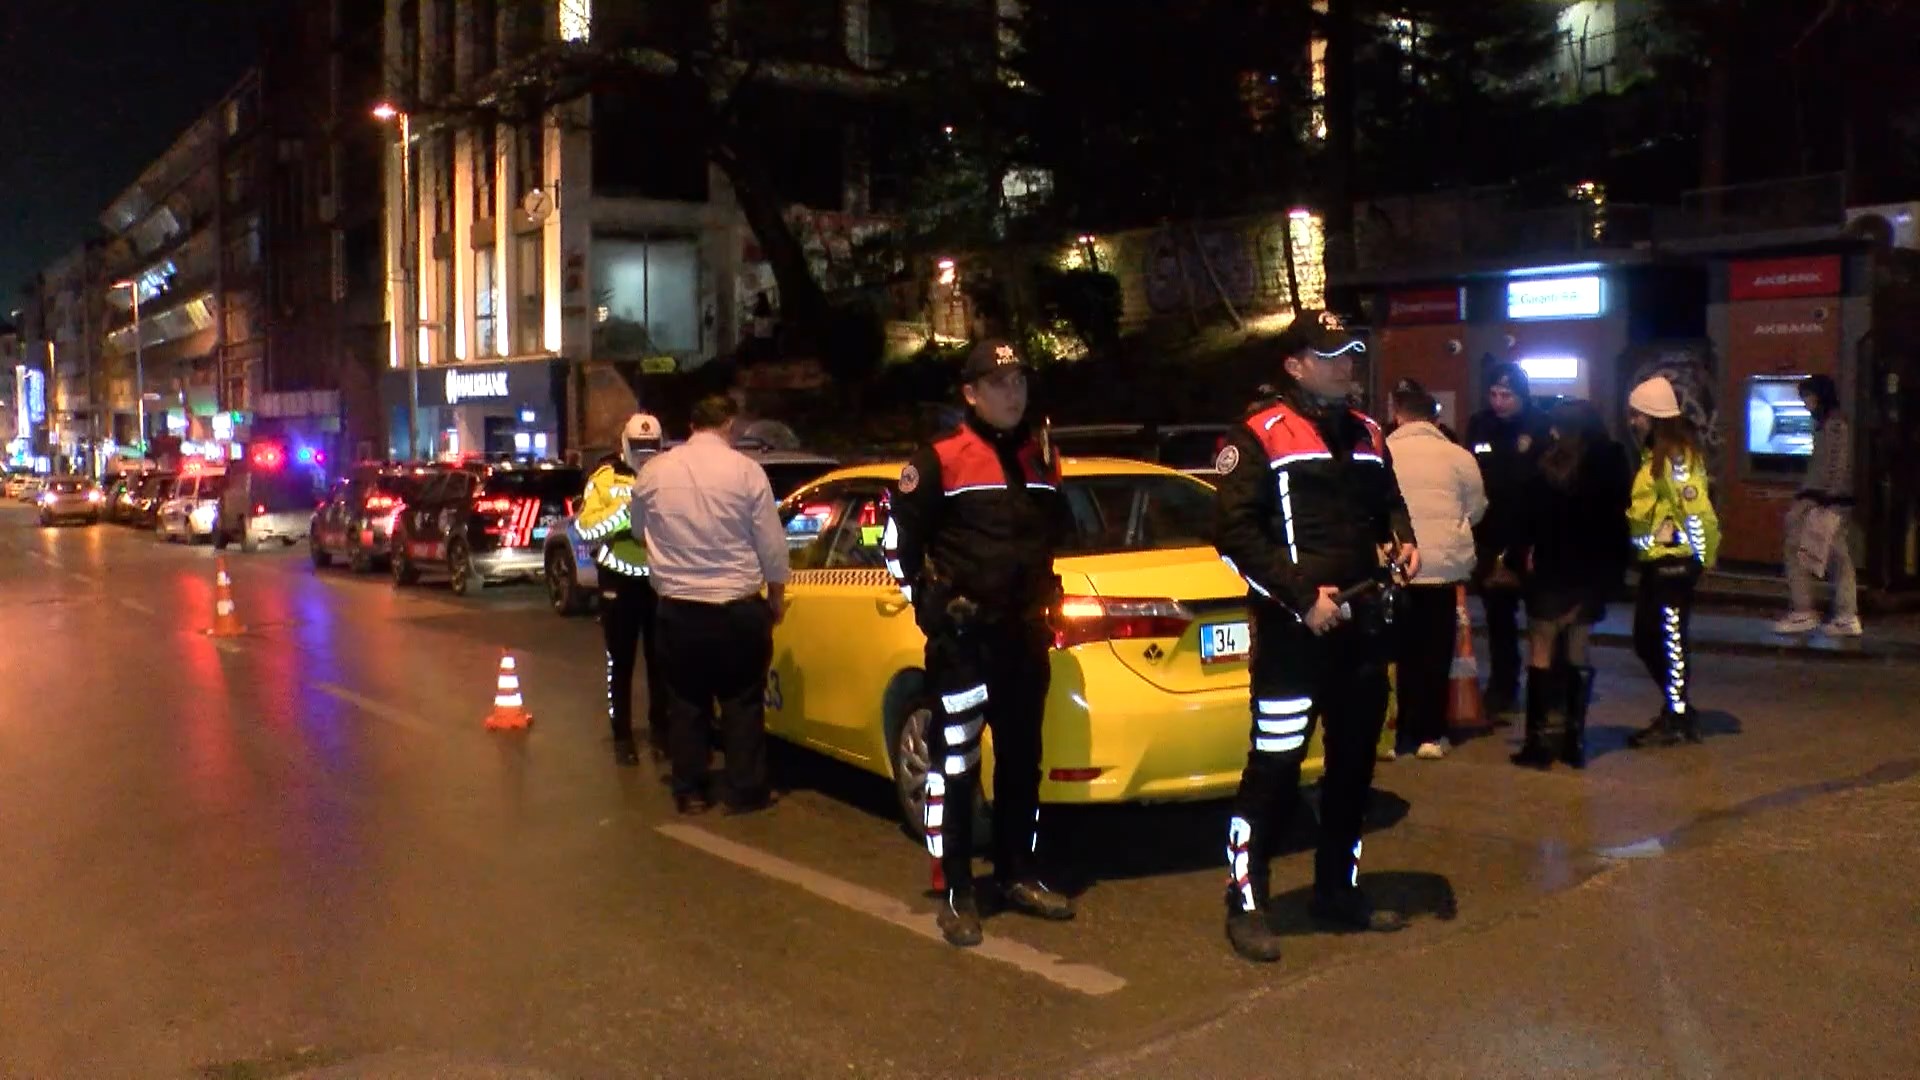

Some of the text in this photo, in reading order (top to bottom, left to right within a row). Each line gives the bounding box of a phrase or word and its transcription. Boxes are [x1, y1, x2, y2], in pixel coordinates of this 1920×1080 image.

[1753, 273, 1822, 287] AKBANK
[1754, 322, 1824, 335] AKBANK
[1215, 627, 1235, 652] 34
